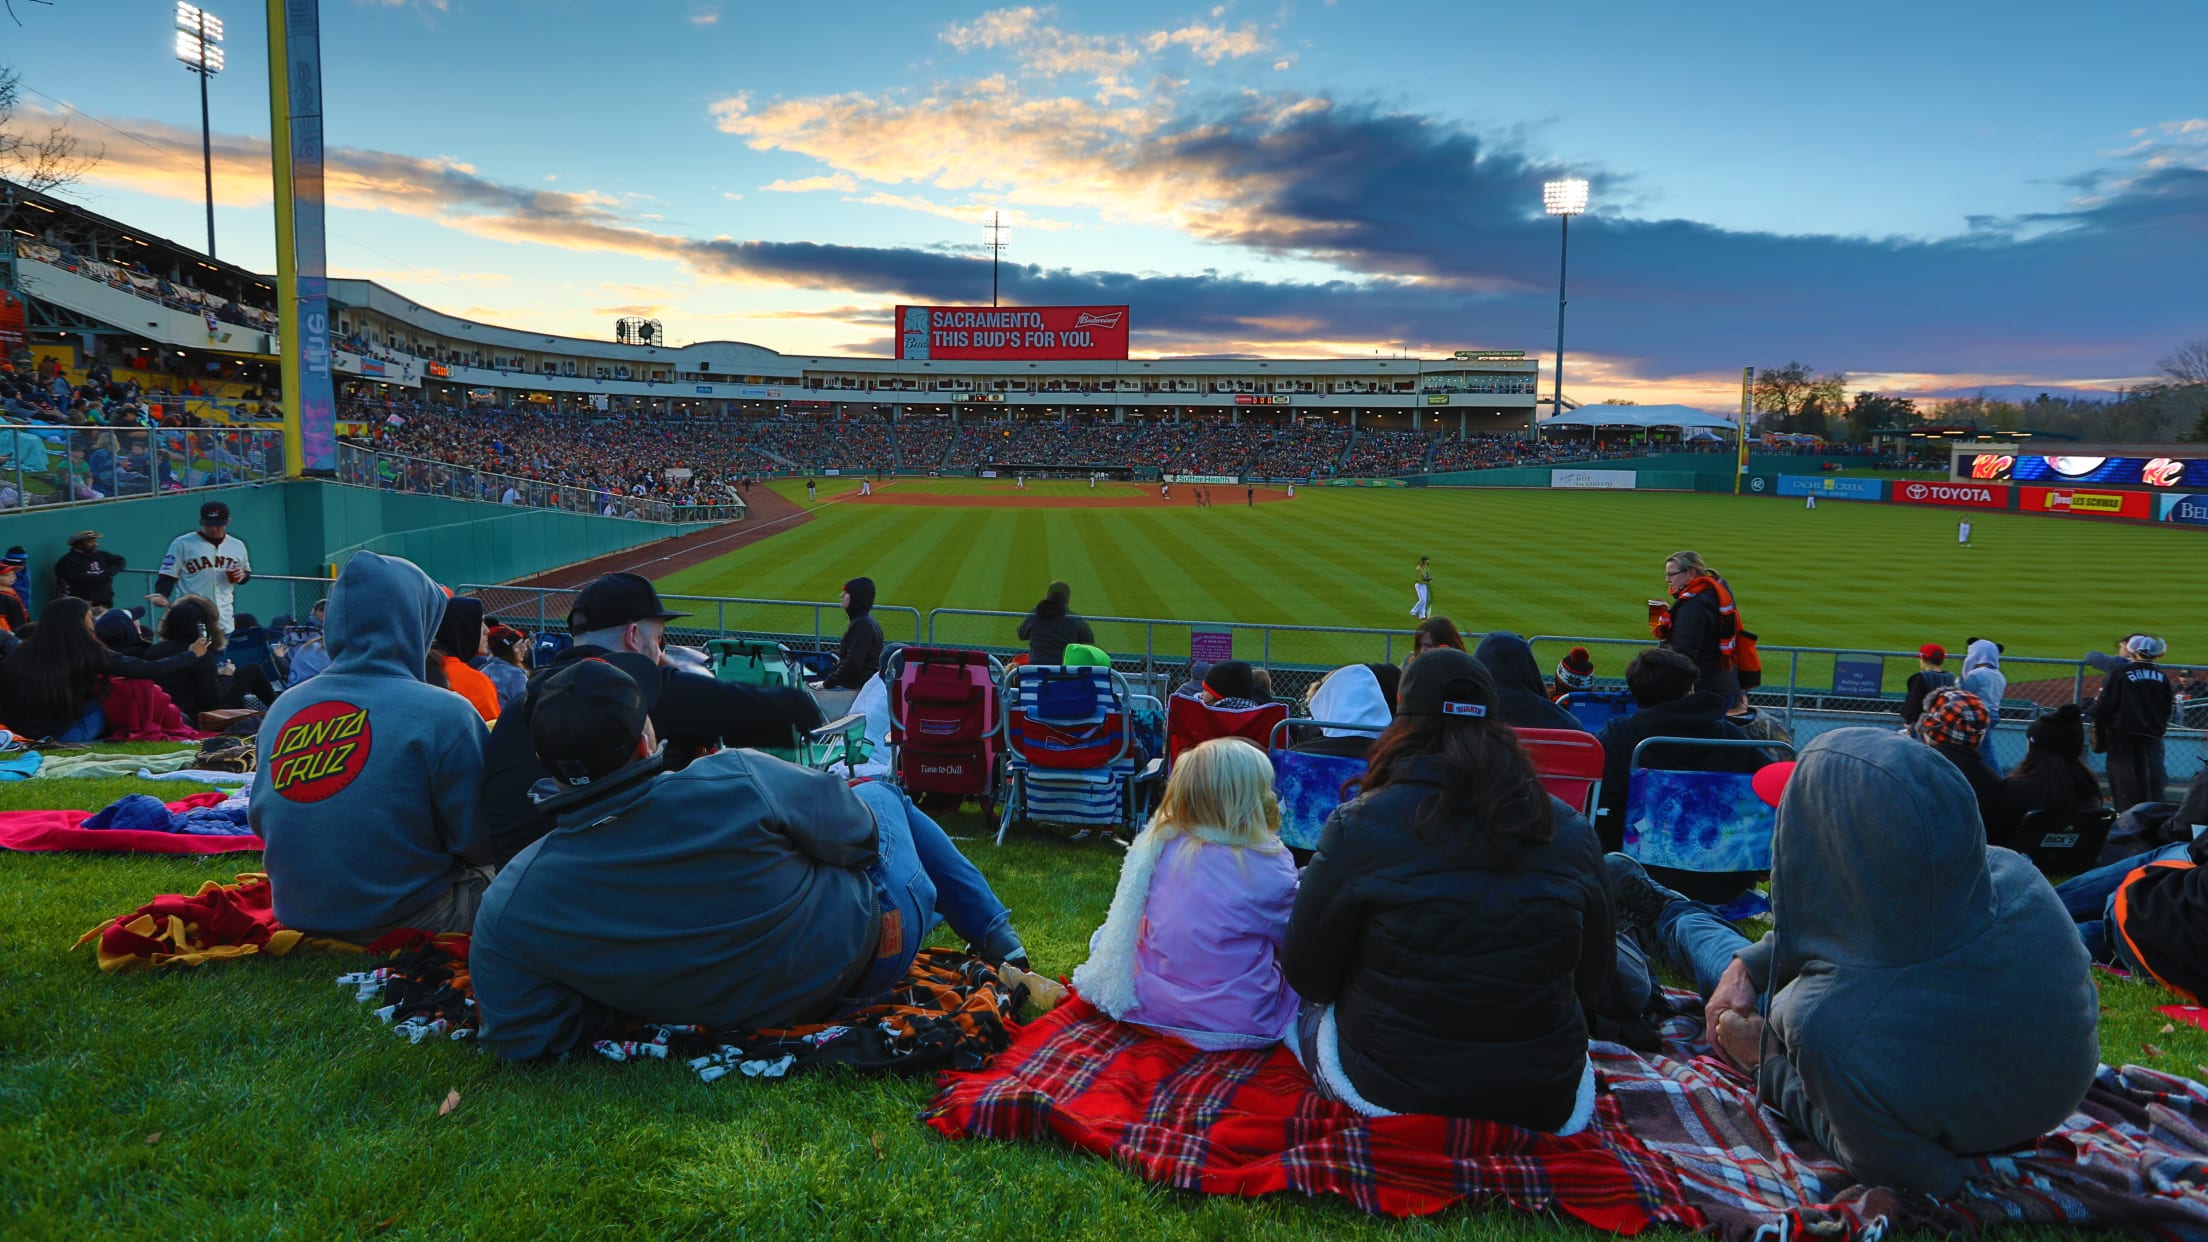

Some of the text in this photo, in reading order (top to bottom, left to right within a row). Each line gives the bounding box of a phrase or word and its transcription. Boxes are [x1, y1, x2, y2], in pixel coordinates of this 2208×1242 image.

[933, 311, 1045, 330] SACRAMENTO,
[932, 331, 1094, 347] THIS BUD'S FOR YOU.
[1179, 475, 1230, 484] Sutter Health
[1753, 479, 1762, 488] 42
[1930, 486, 1991, 502] TOYOTA
[269, 708, 370, 762] SANTA
[273, 741, 358, 792] CRUZ
[920, 764, 938, 774] Time
[946, 764, 963, 775] Chill
